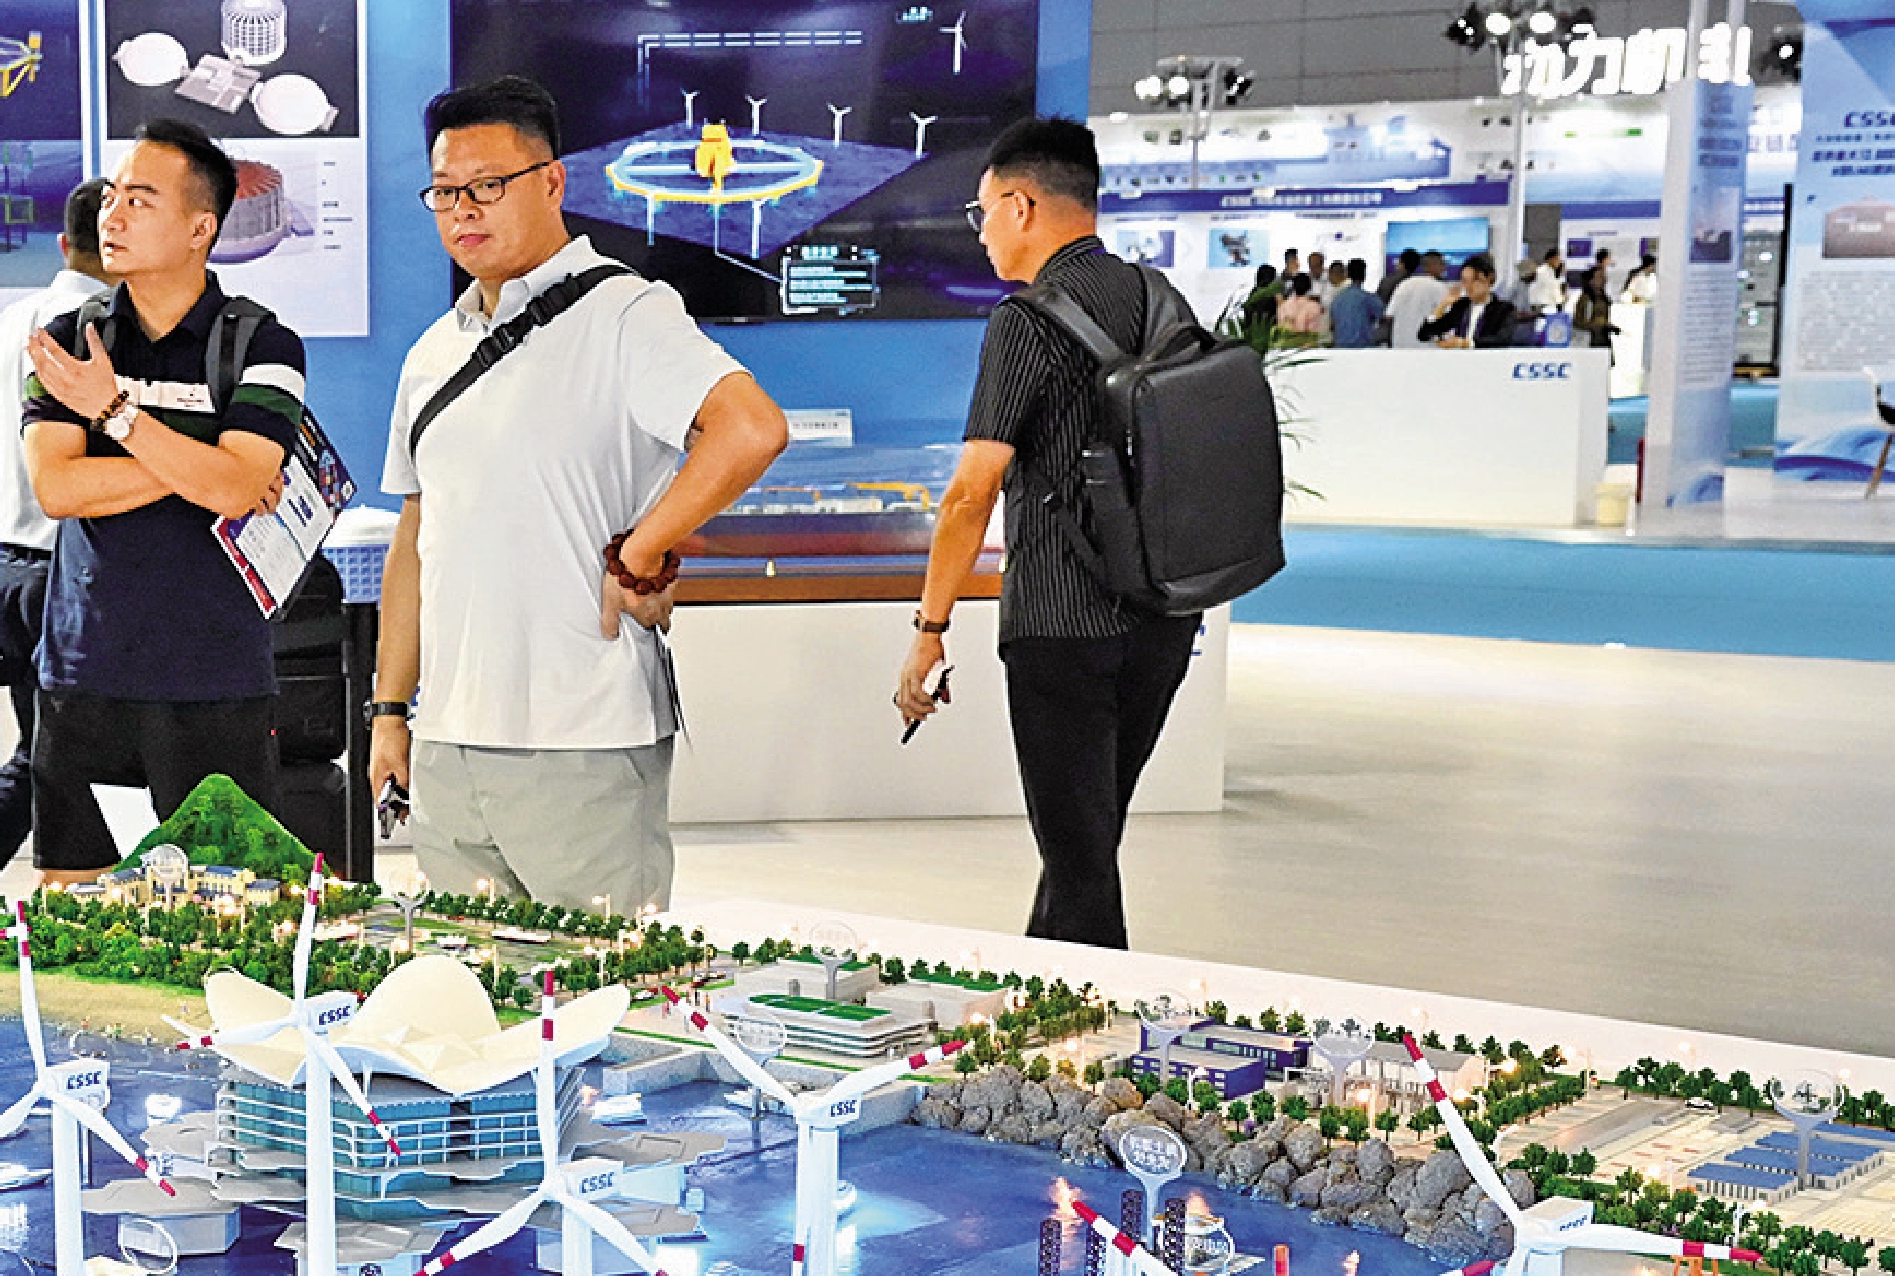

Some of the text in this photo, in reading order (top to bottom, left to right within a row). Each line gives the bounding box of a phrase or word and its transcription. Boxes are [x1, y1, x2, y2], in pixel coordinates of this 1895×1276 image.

[1512, 362, 1572, 379] CSSC
[319, 1005, 351, 1025] CSSC
[67, 1070, 101, 1090] CSSC
[831, 1099, 857, 1118] CSSC
[582, 1171, 615, 1194] CSSC
